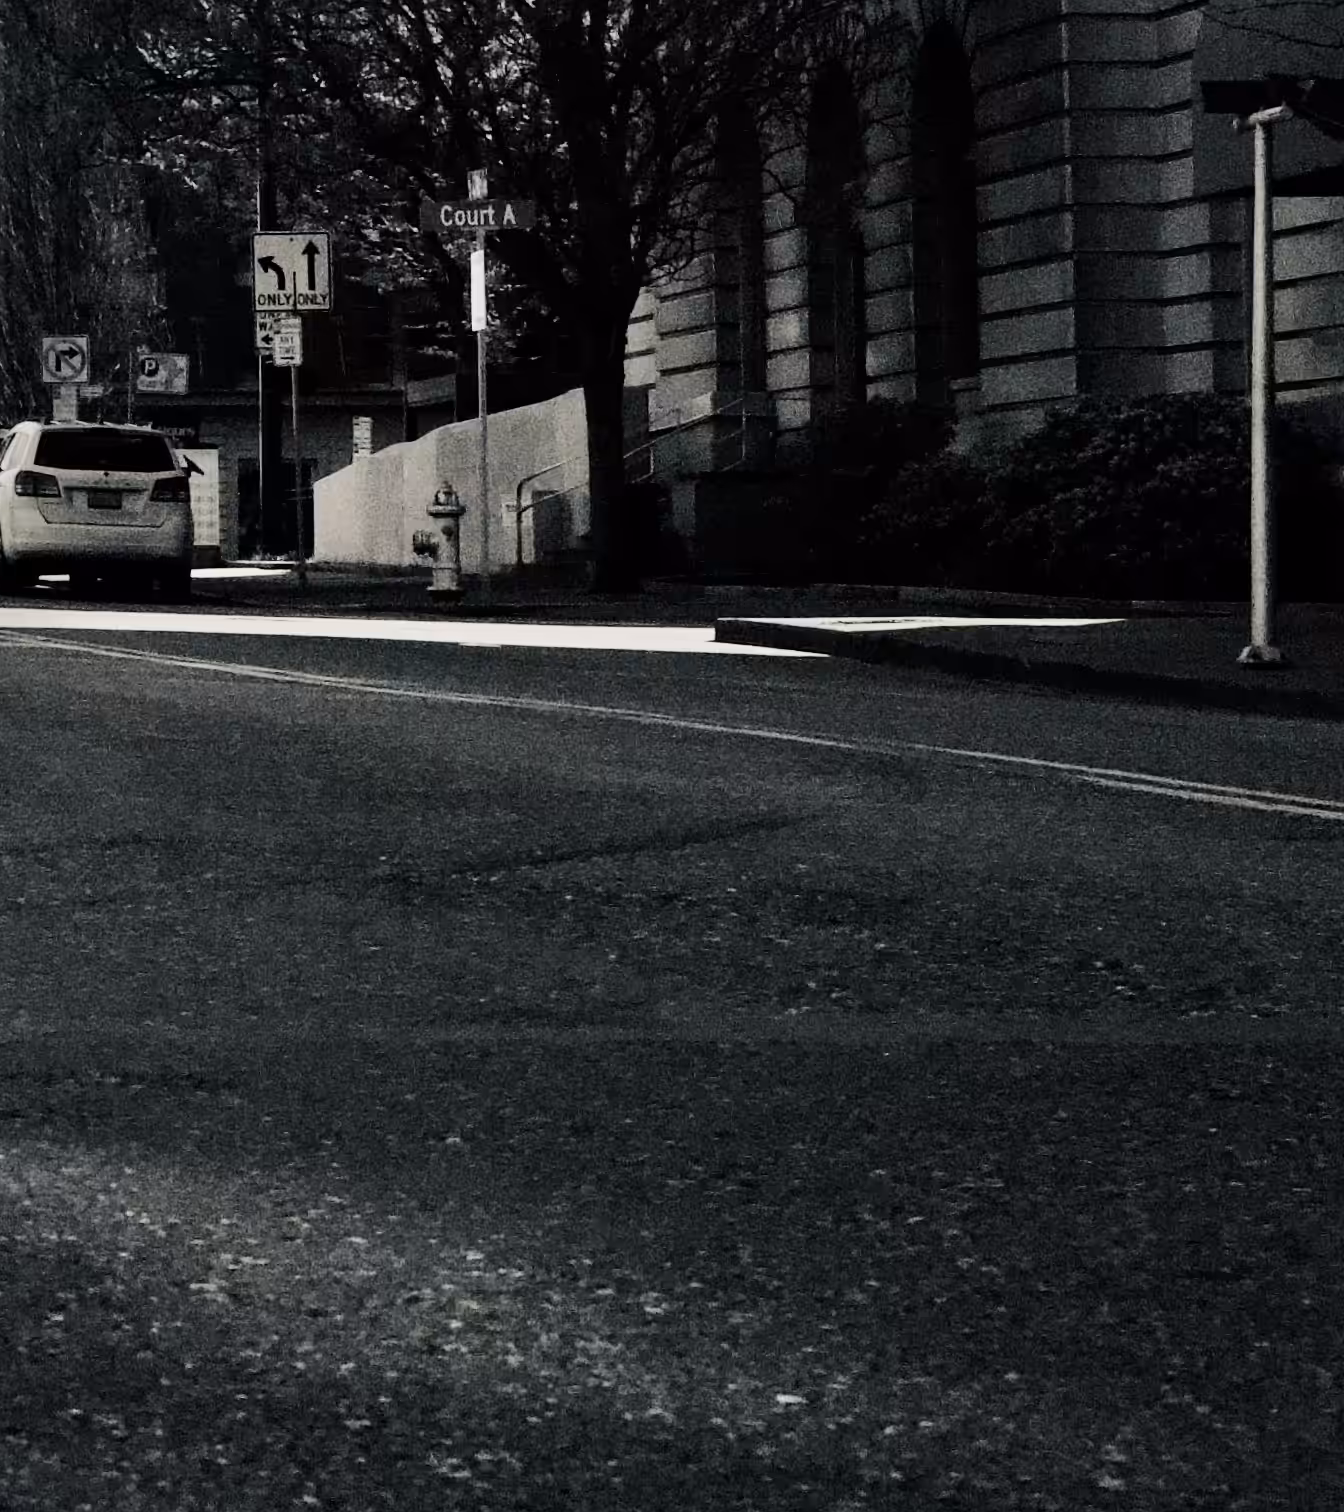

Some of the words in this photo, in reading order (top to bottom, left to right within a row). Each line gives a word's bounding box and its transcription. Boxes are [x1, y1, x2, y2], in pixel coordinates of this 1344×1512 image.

[440, 204, 495, 226] Court
[503, 203, 516, 225] A
[257, 293, 292, 307] ONLY
[297, 293, 328, 306] ONLY
[144, 359, 156, 375] P
